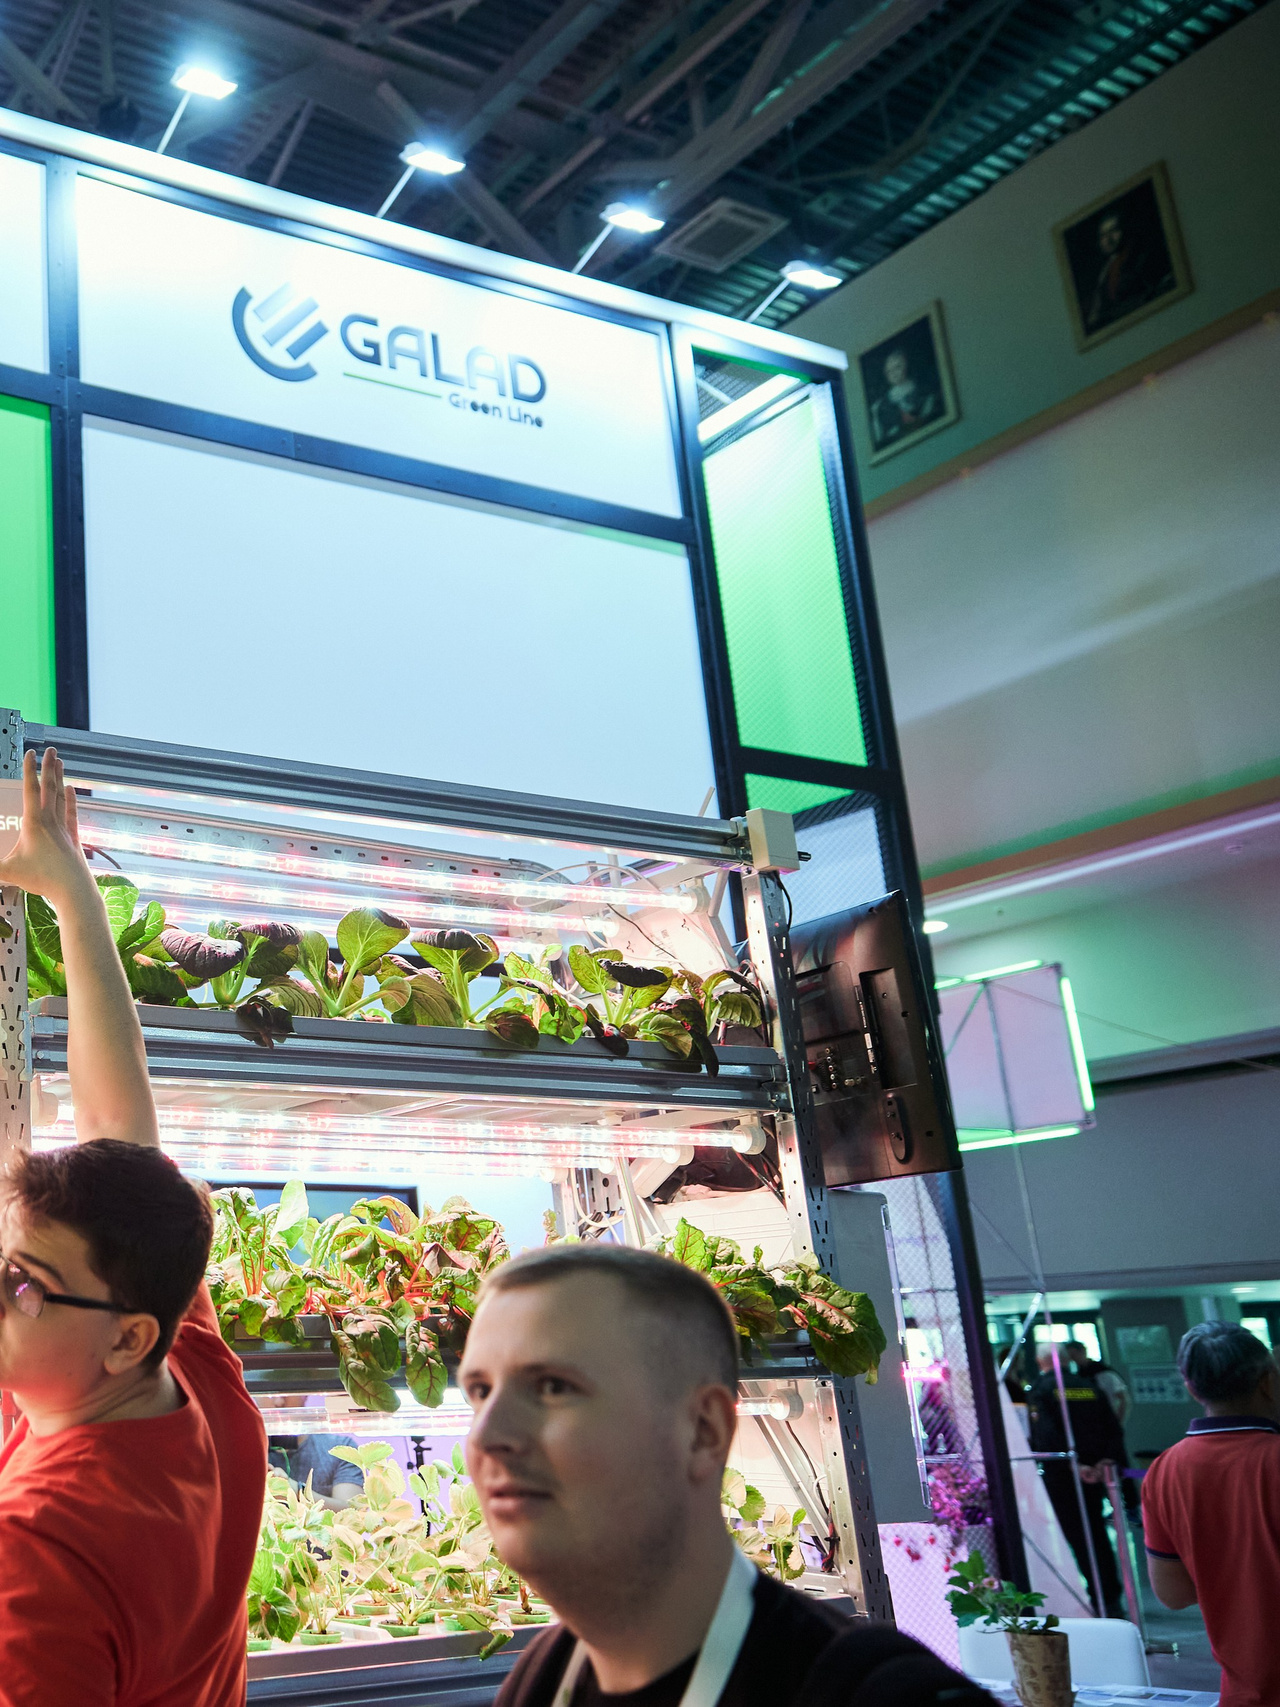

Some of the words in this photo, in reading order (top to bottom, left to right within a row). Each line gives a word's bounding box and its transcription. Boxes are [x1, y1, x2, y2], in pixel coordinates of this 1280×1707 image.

[340, 313, 547, 404] GALAD
[449, 393, 502, 418] Green
[508, 406, 543, 428] Line
